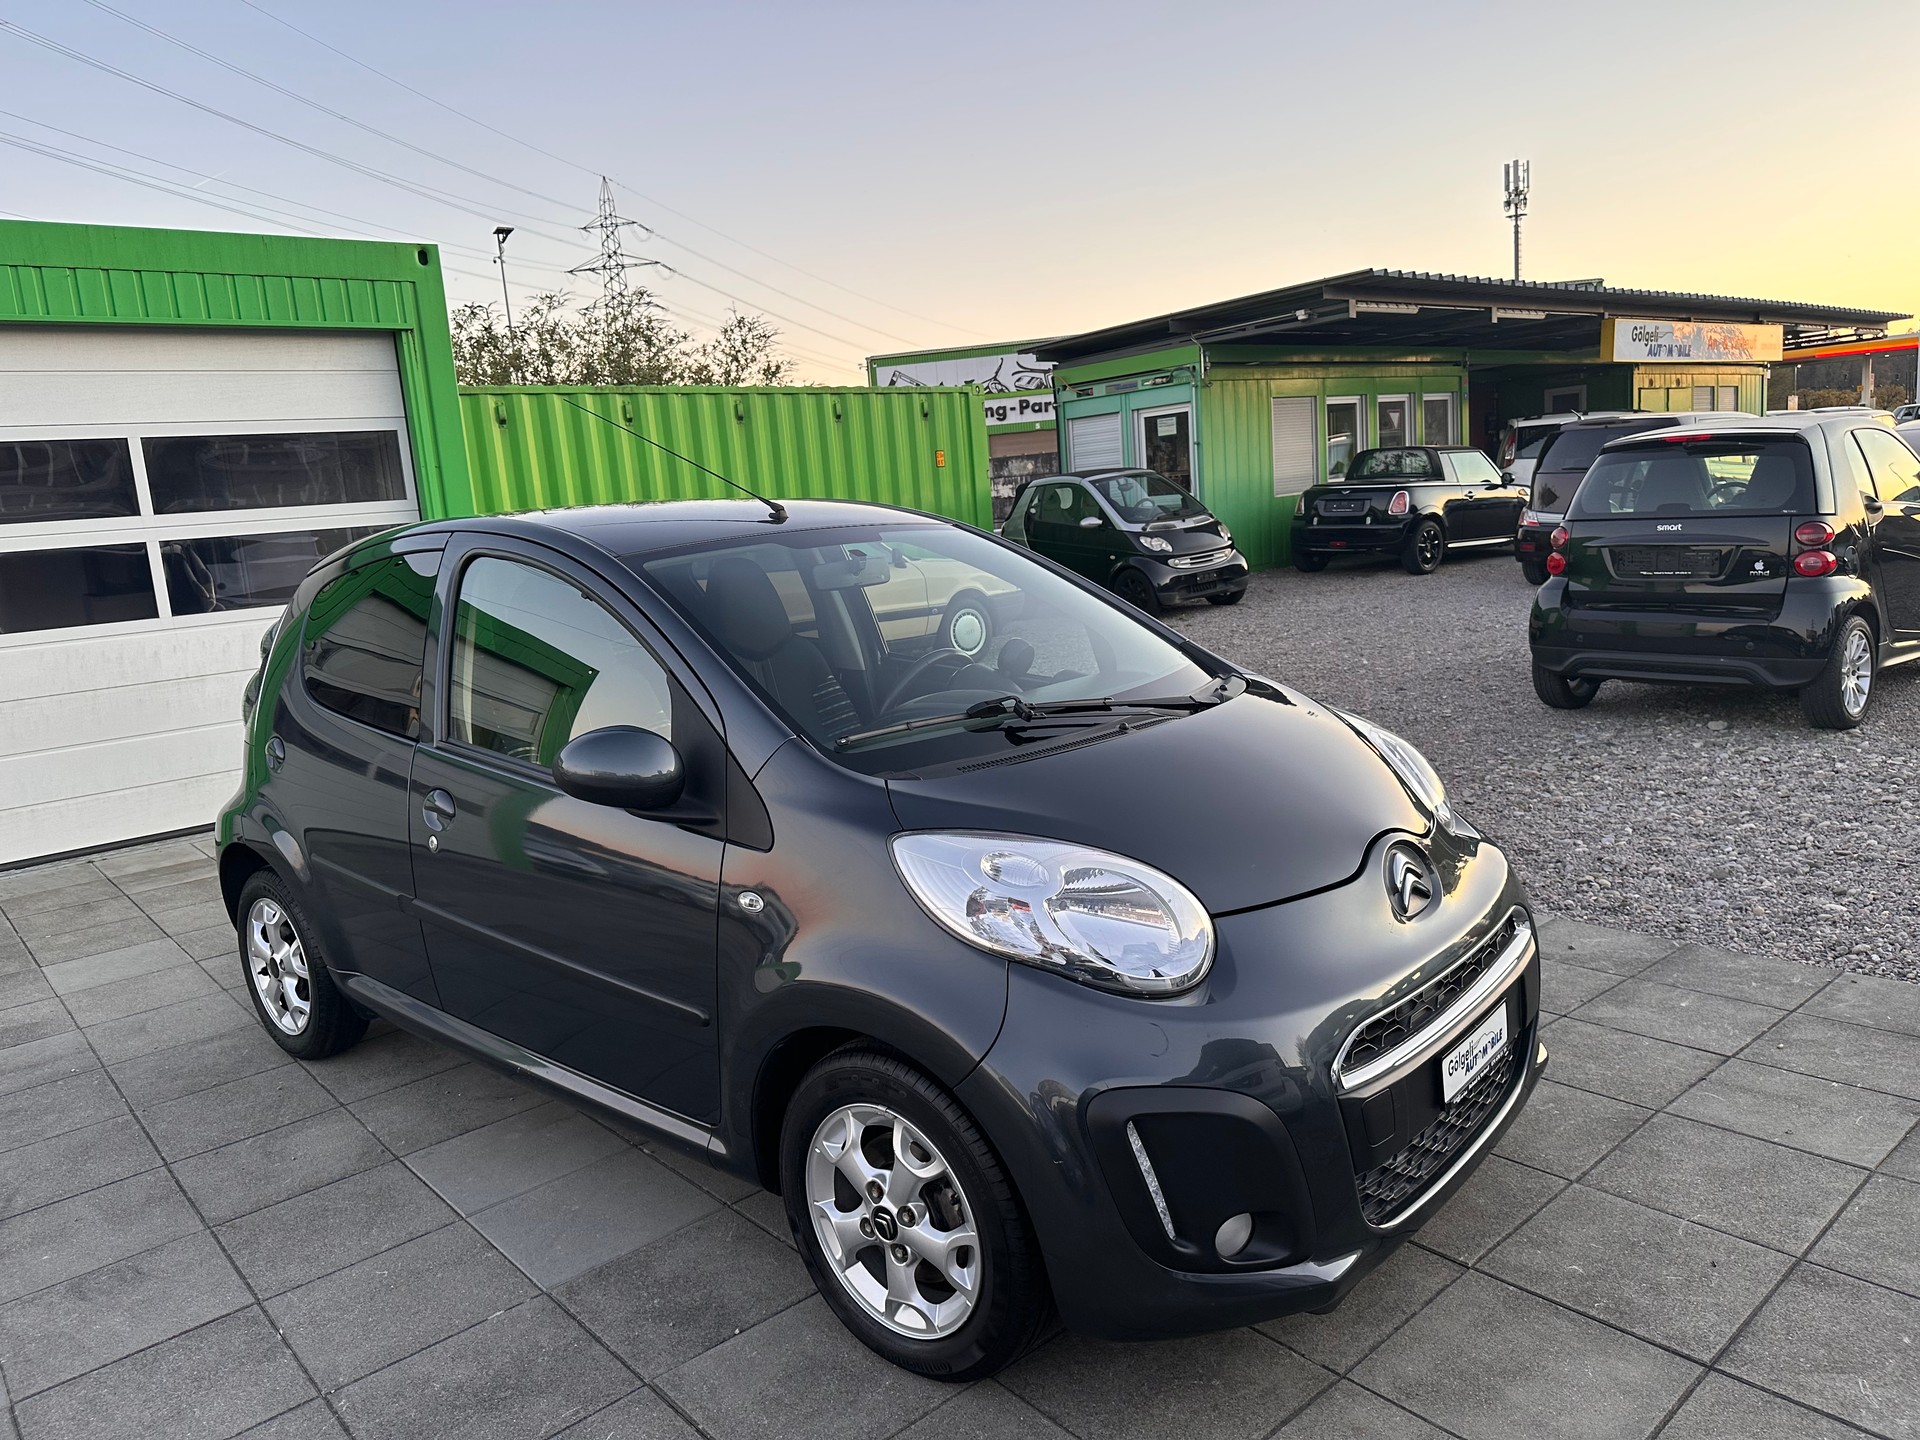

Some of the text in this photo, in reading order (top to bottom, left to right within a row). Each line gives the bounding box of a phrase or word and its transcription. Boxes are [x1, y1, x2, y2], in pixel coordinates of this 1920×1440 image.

[1631, 325, 1659, 347] Gölgeli
[1656, 523, 1682, 531] smart
[1448, 1040, 1474, 1077] Gölgeli
